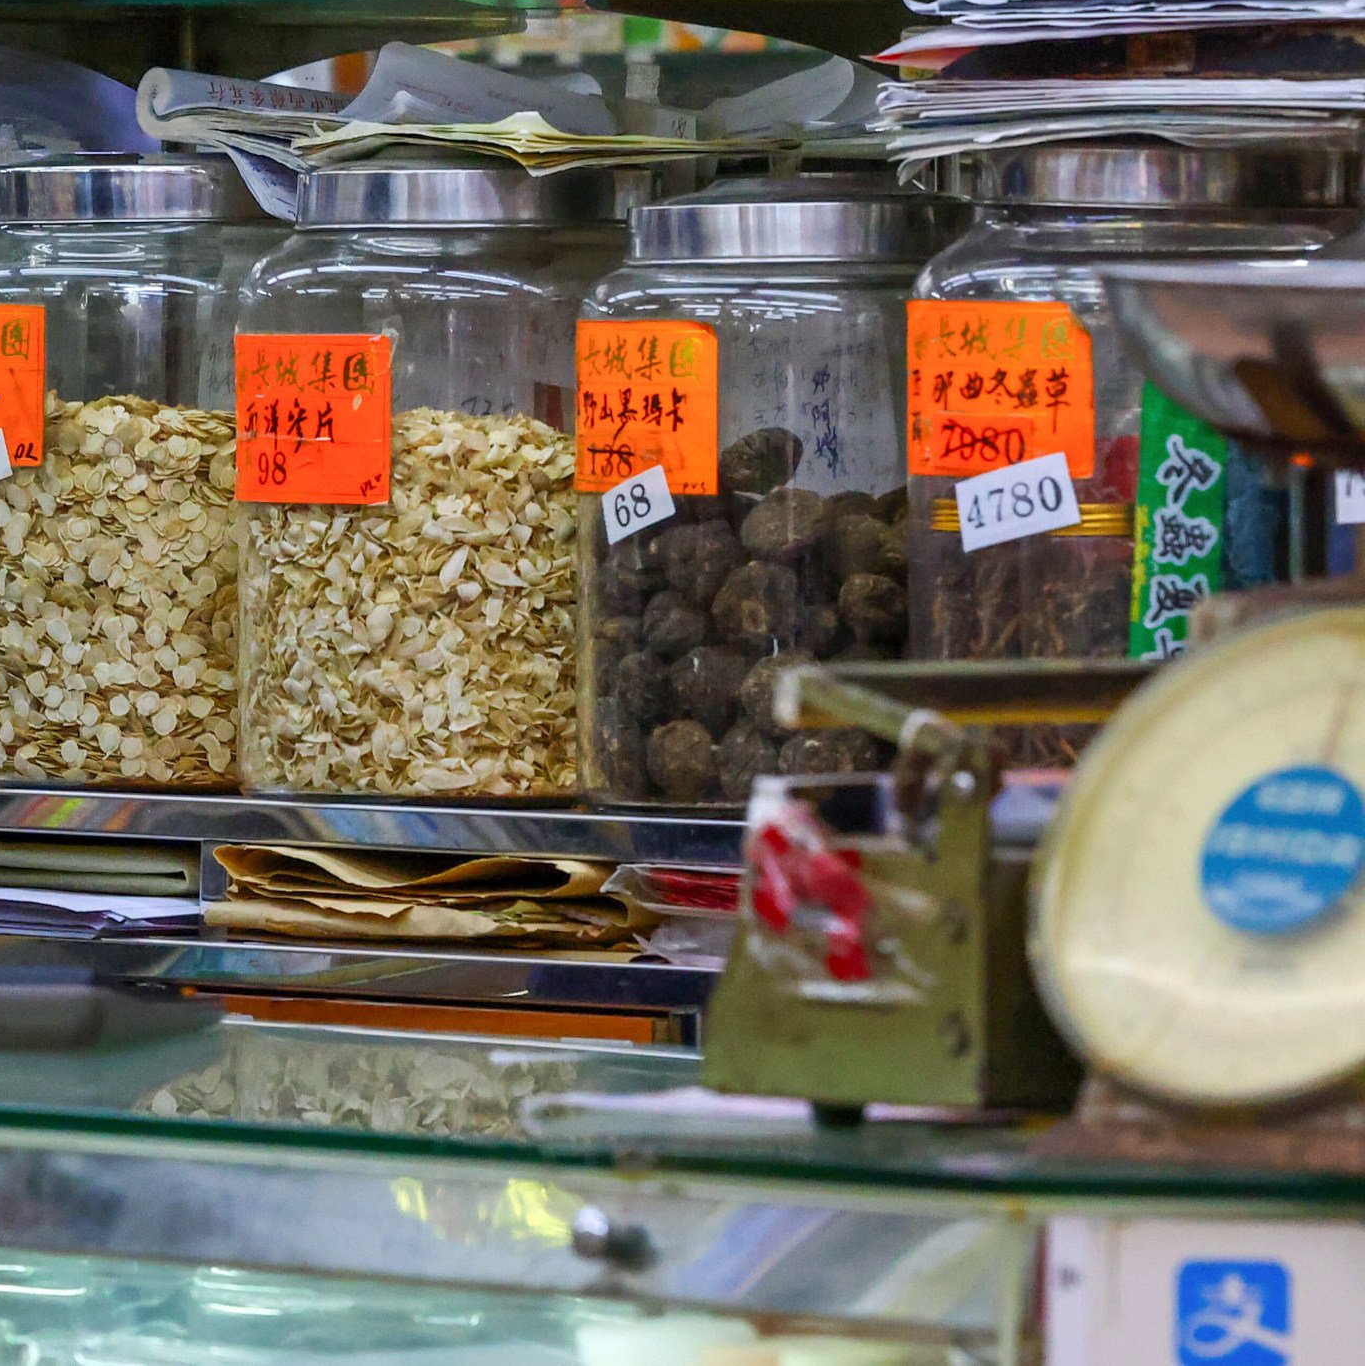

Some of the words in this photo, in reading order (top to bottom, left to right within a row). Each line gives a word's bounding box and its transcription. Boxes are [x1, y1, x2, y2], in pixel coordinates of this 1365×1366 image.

[258, 451, 287, 485] 98
[614, 483, 652, 528] 68
[966, 475, 1064, 530] 4780
